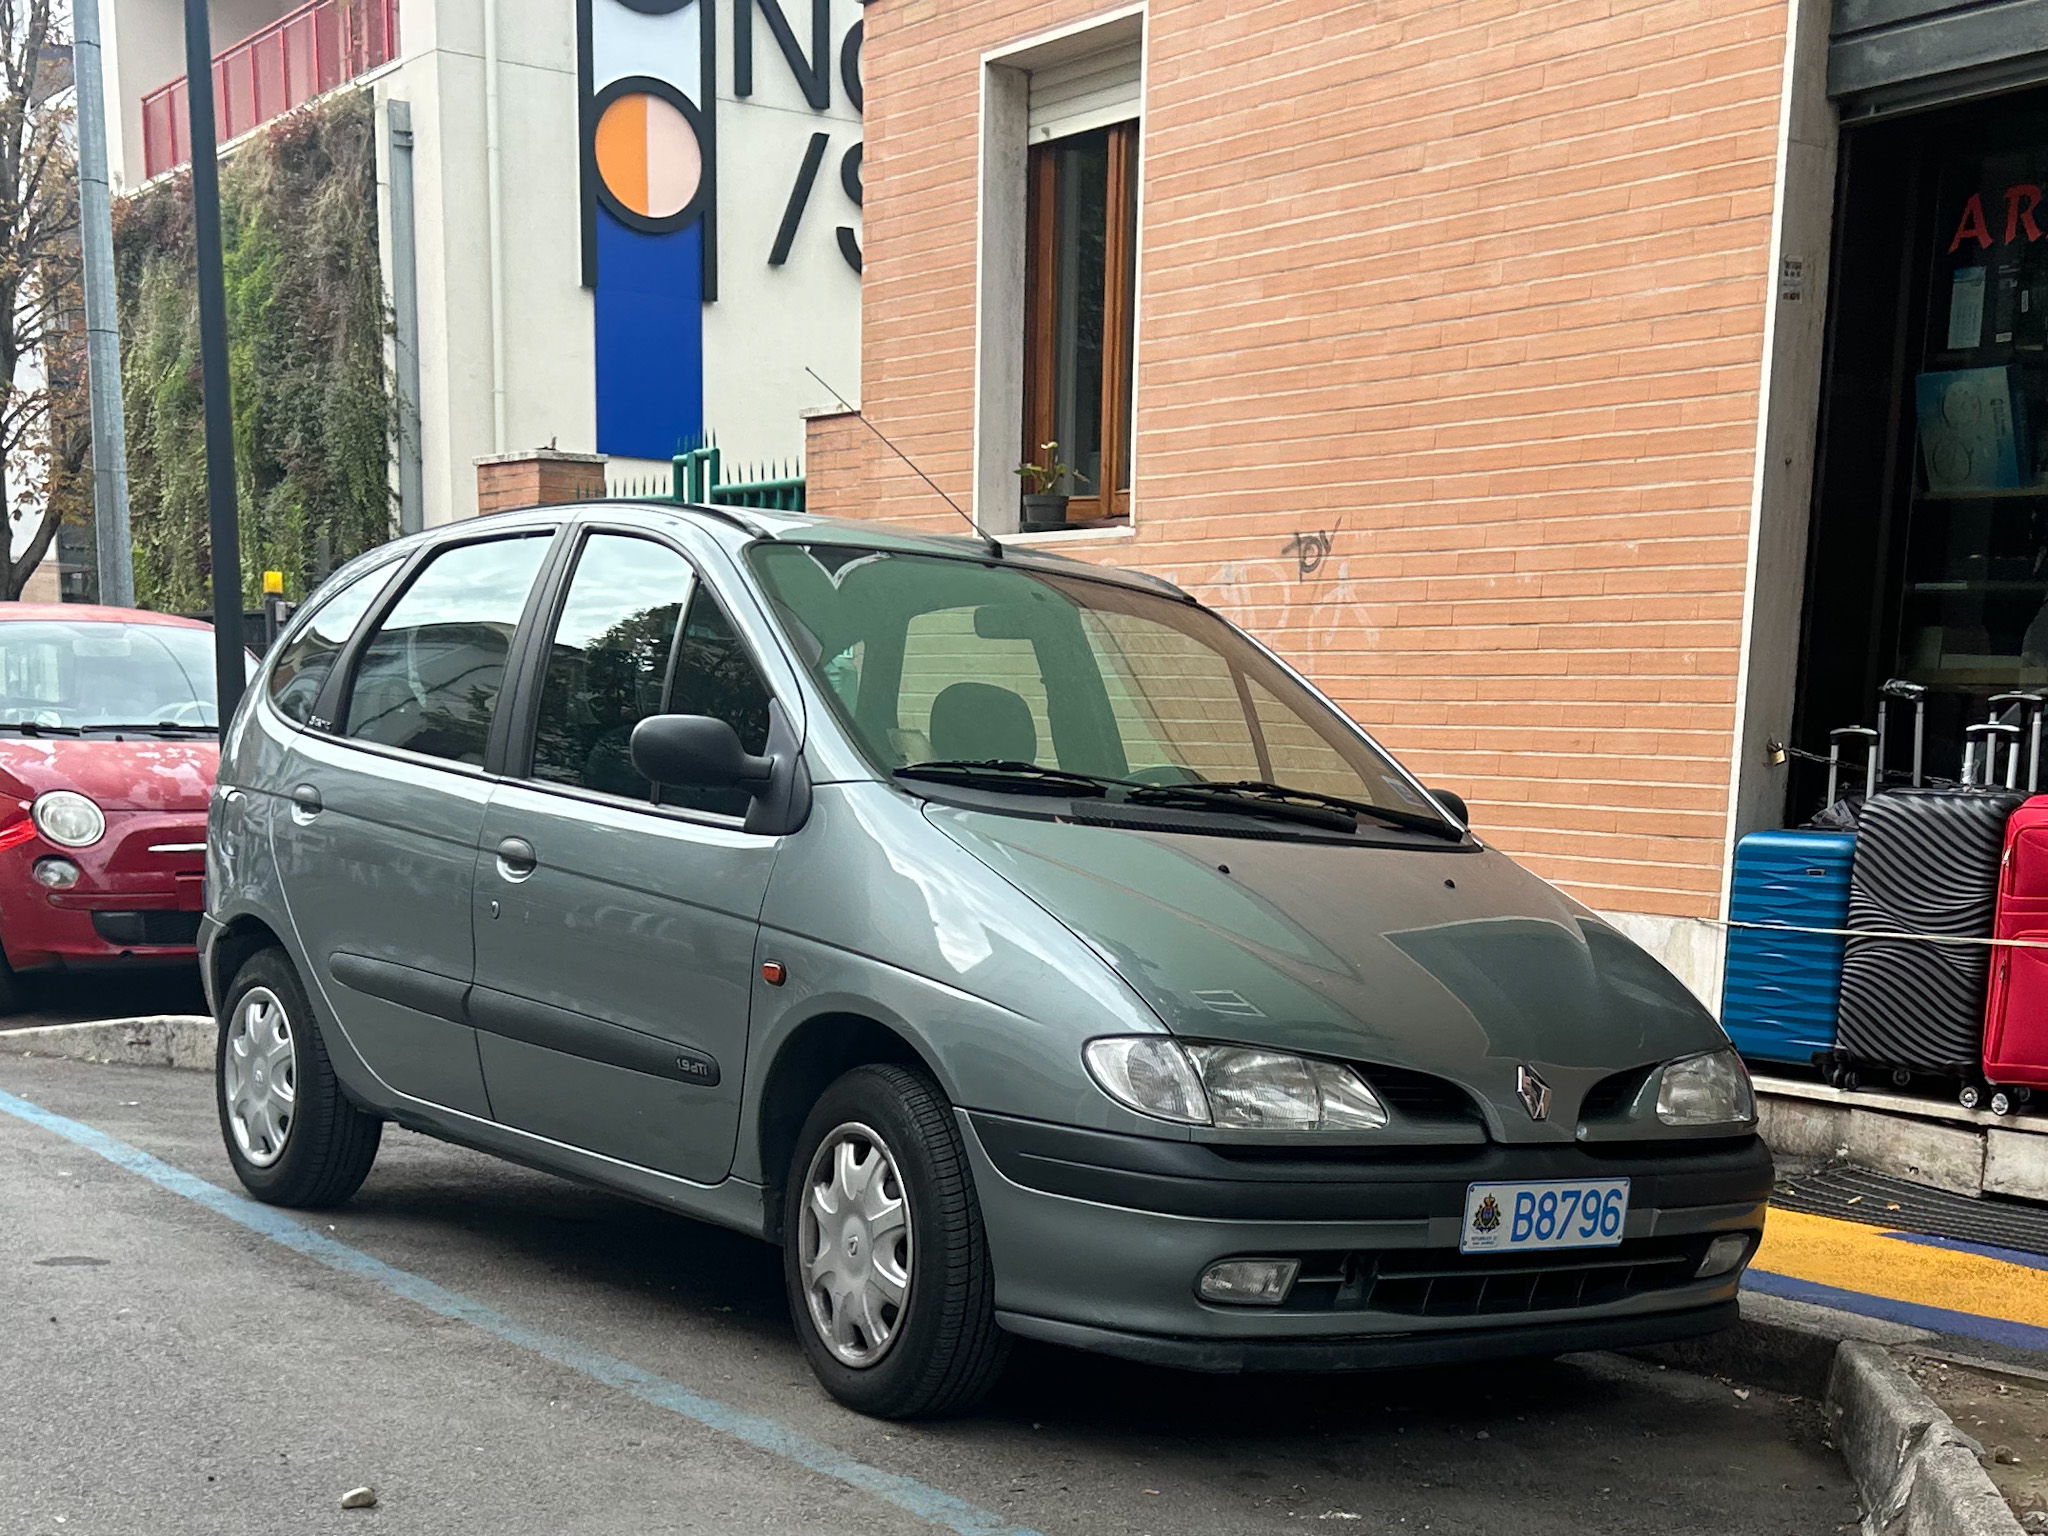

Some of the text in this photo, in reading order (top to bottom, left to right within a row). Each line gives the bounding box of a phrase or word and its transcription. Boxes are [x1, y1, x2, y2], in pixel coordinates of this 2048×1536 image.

[734, 0, 863, 115] N
[1948, 183, 2048, 254] AR
[1510, 1188, 1623, 1242] B8796
